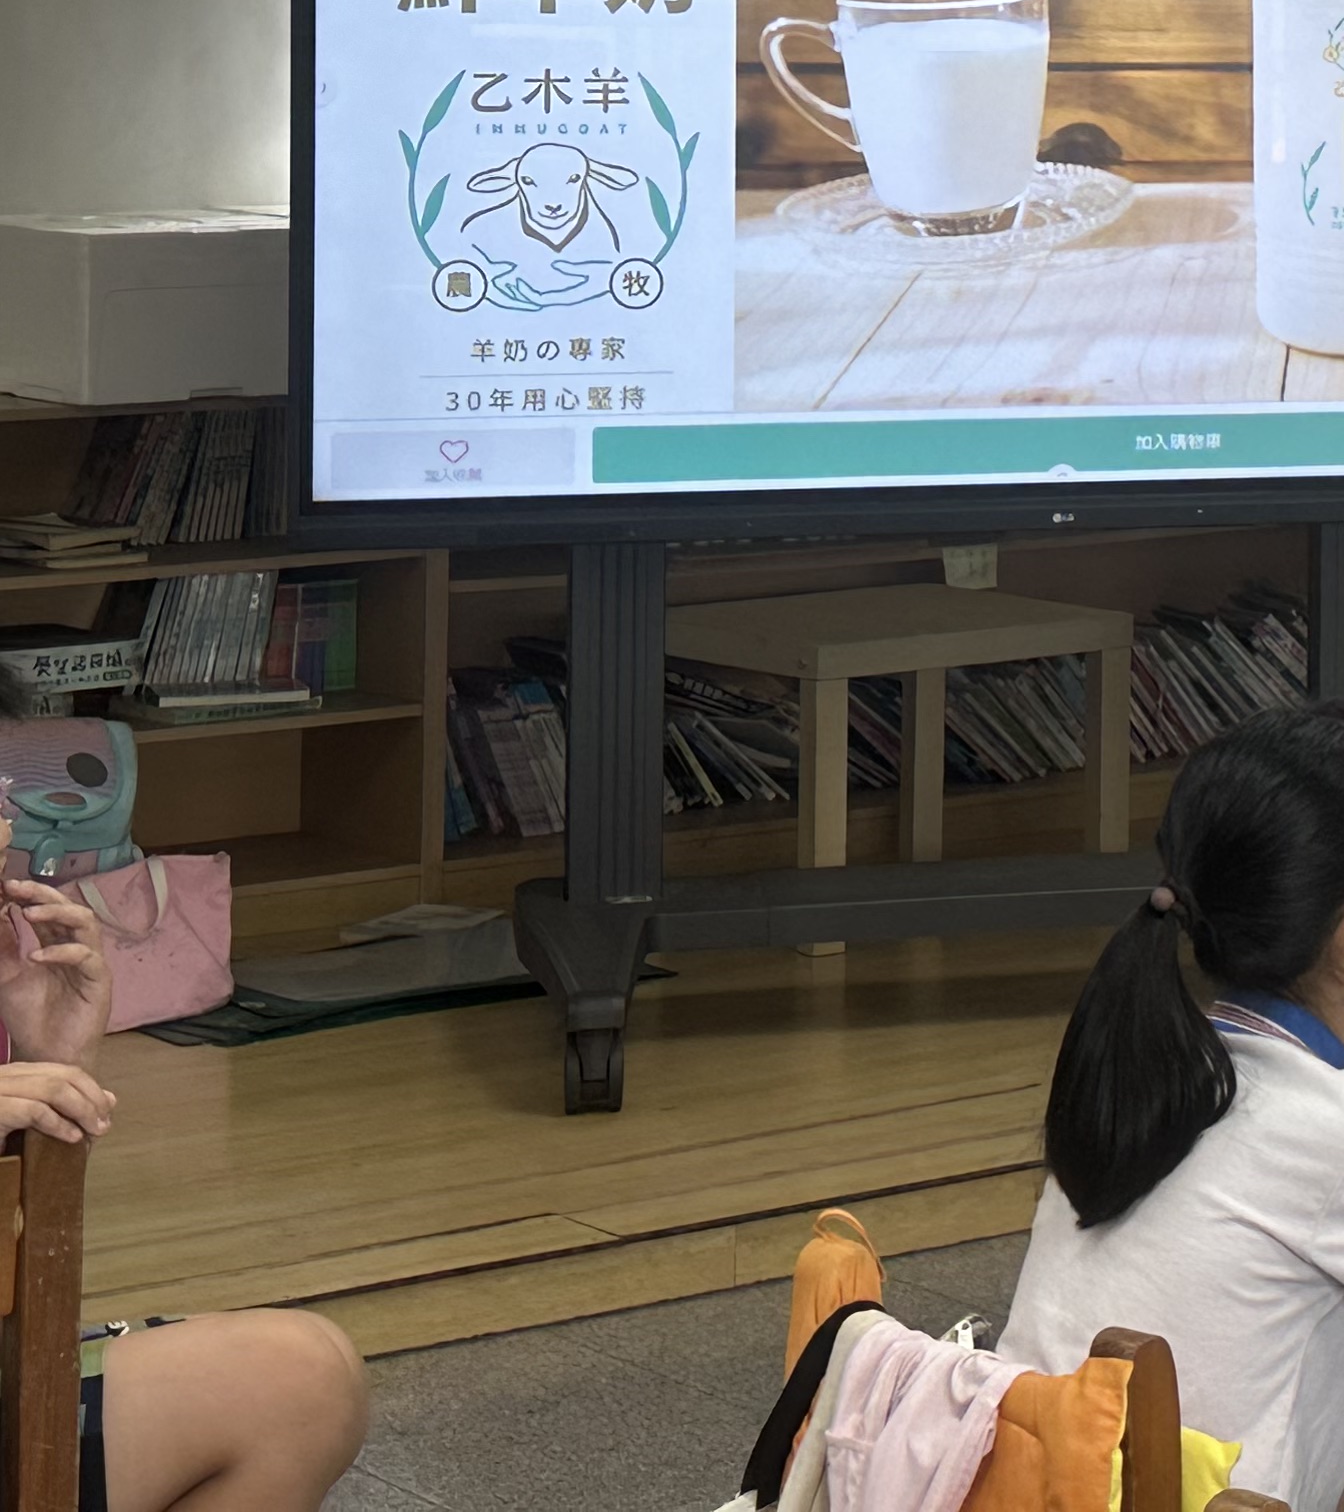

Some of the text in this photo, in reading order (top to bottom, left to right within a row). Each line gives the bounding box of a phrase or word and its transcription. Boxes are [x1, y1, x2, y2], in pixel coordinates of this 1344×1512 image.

[470, 66, 630, 115] 乙木羊
[622, 270, 651, 297] 牧
[470, 336, 626, 363] 羊奶の專家
[445, 384, 646, 412] 30年用心堅持
